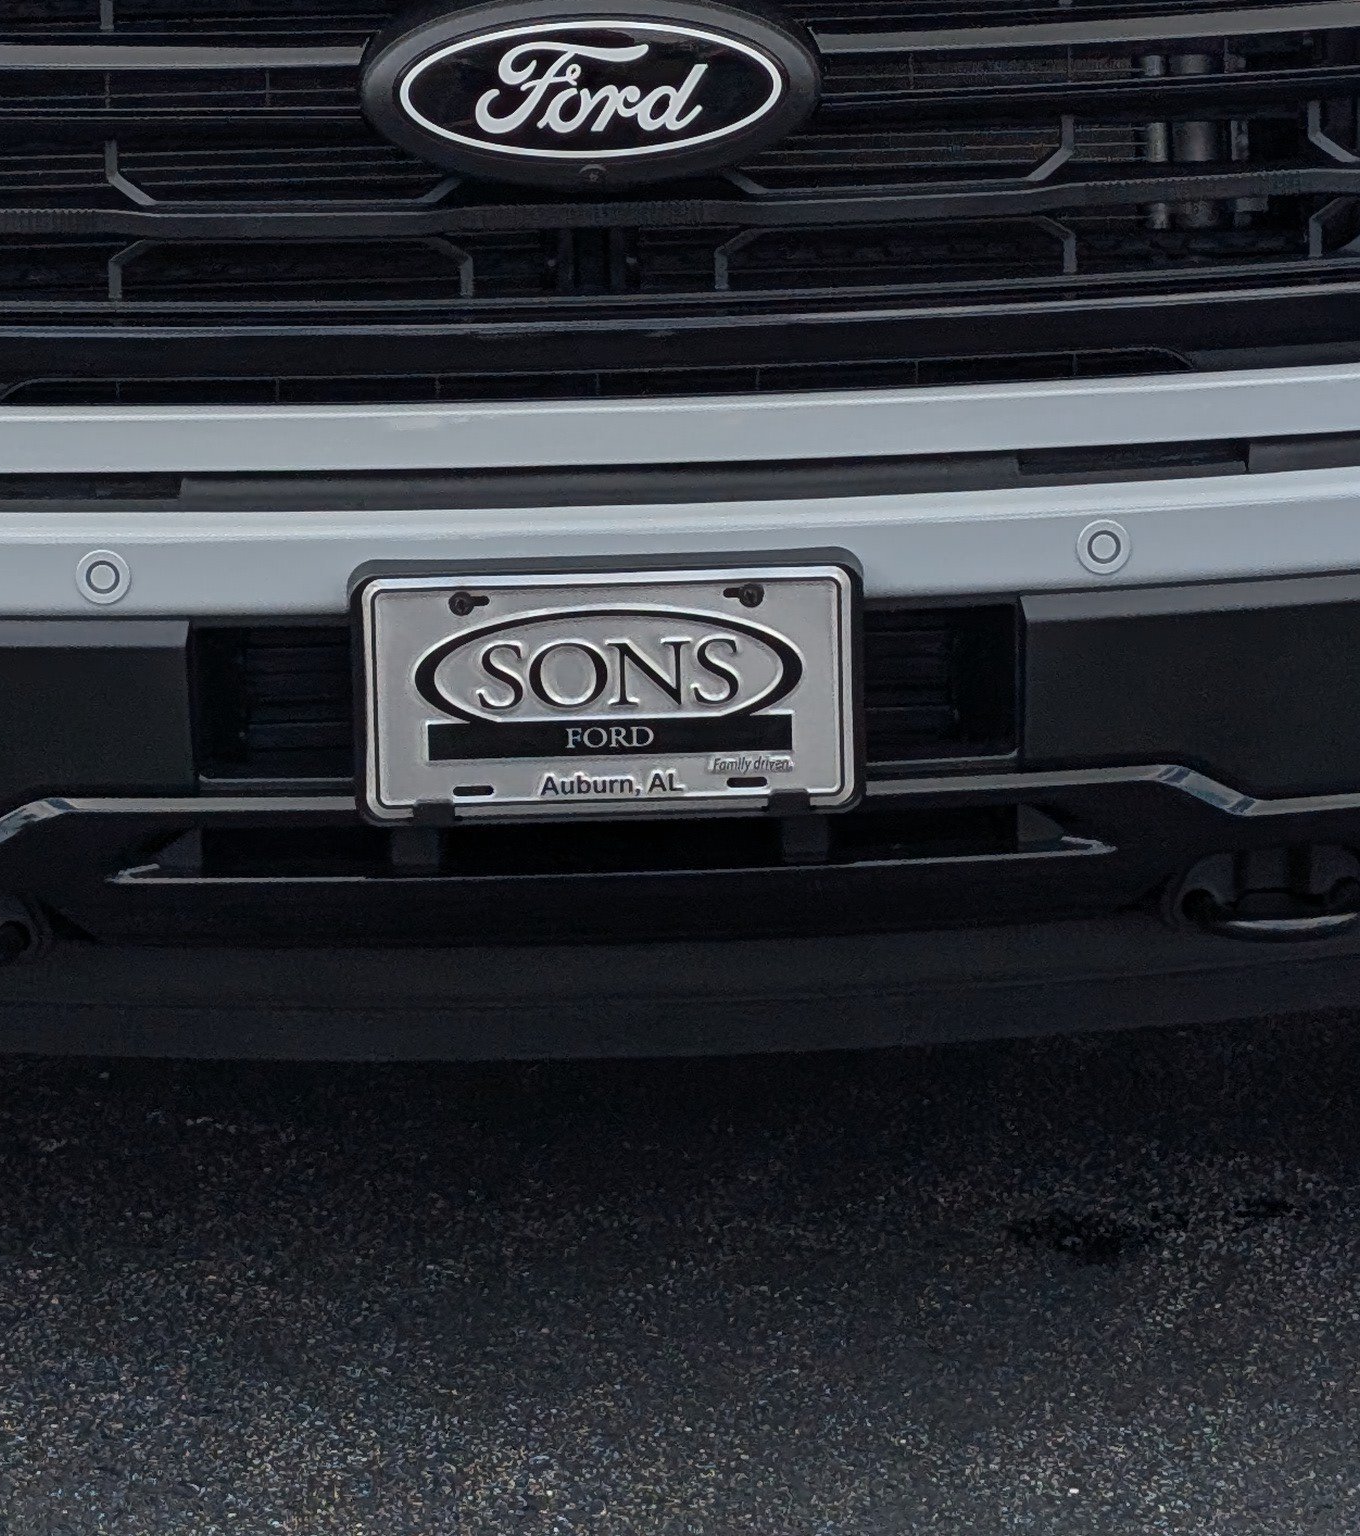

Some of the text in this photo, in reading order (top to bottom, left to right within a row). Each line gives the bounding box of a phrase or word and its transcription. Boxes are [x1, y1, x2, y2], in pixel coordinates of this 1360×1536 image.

[475, 41, 708, 134] Ford
[476, 637, 740, 709] SONS
[565, 725, 654, 749] FORD
[713, 756, 752, 775] Family
[540, 772, 684, 797] Auburn, AL
